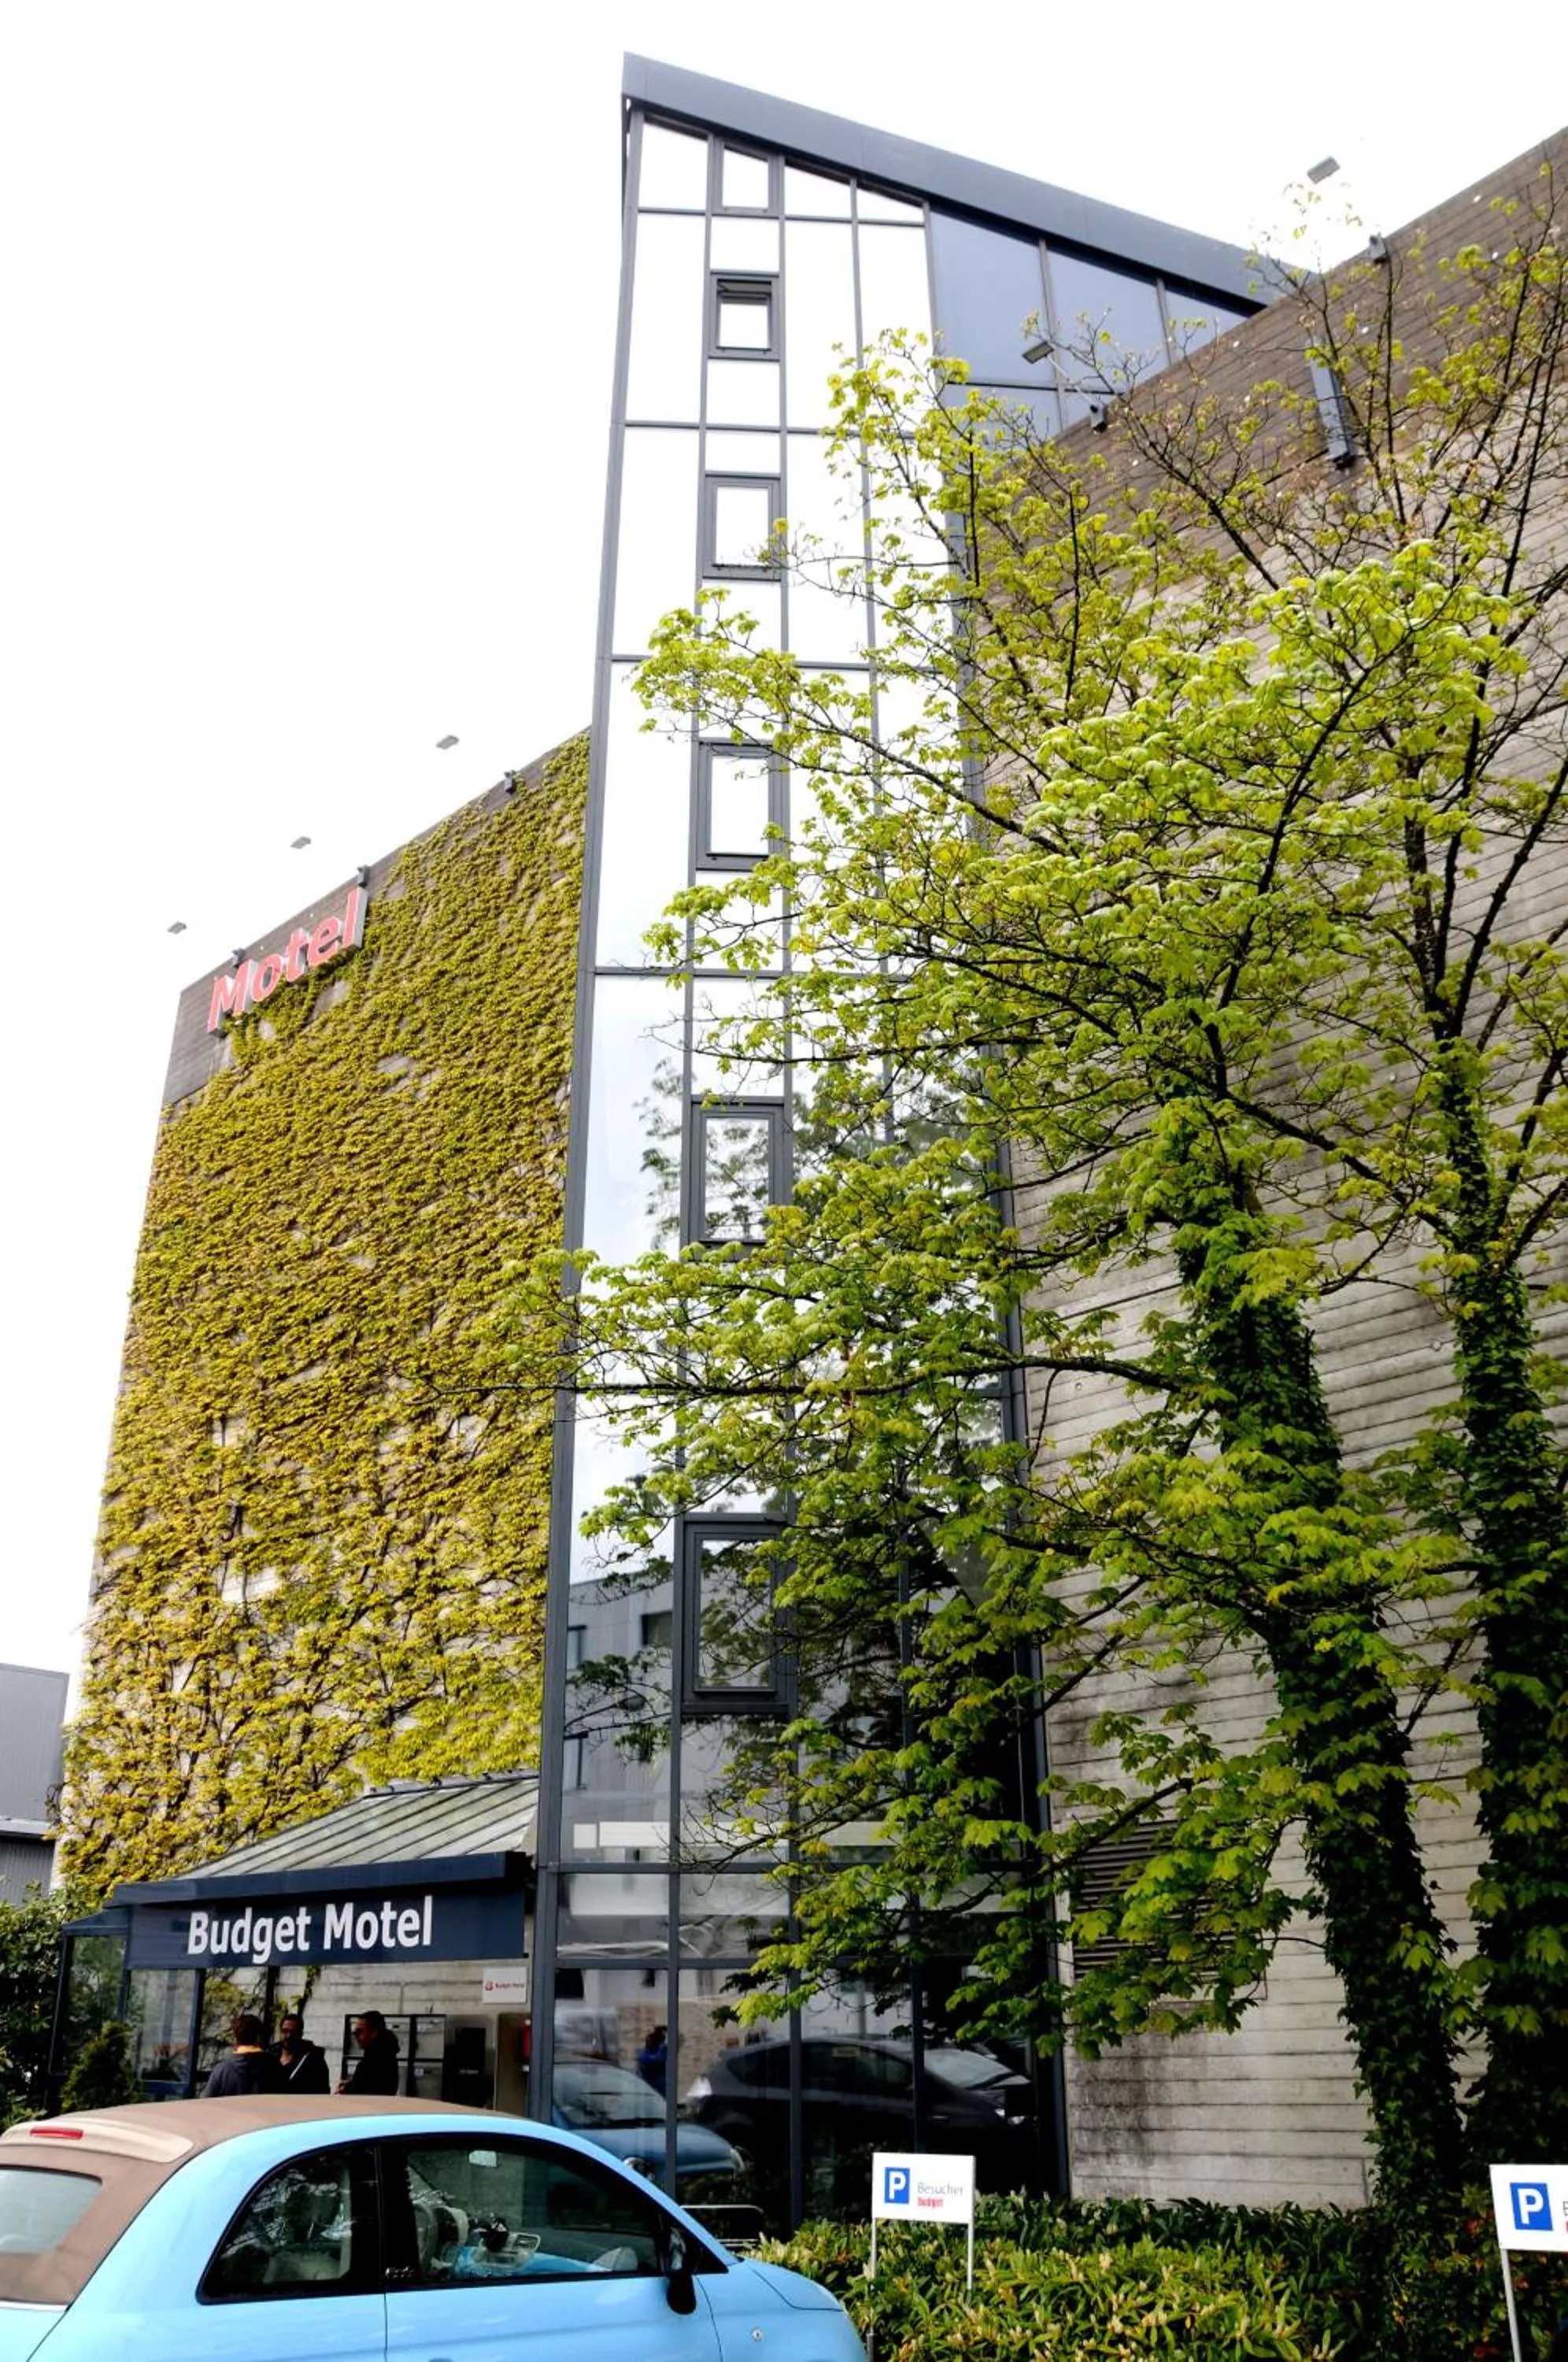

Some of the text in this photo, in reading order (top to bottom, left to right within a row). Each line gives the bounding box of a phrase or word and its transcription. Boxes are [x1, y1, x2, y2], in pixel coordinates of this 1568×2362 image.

[207, 887, 361, 1033] Motel
[187, 1895, 432, 1964] Budget Motel
[889, 2171, 906, 2200] P
[917, 2181, 963, 2196] Besucher
[1517, 2188, 1544, 2224] P
